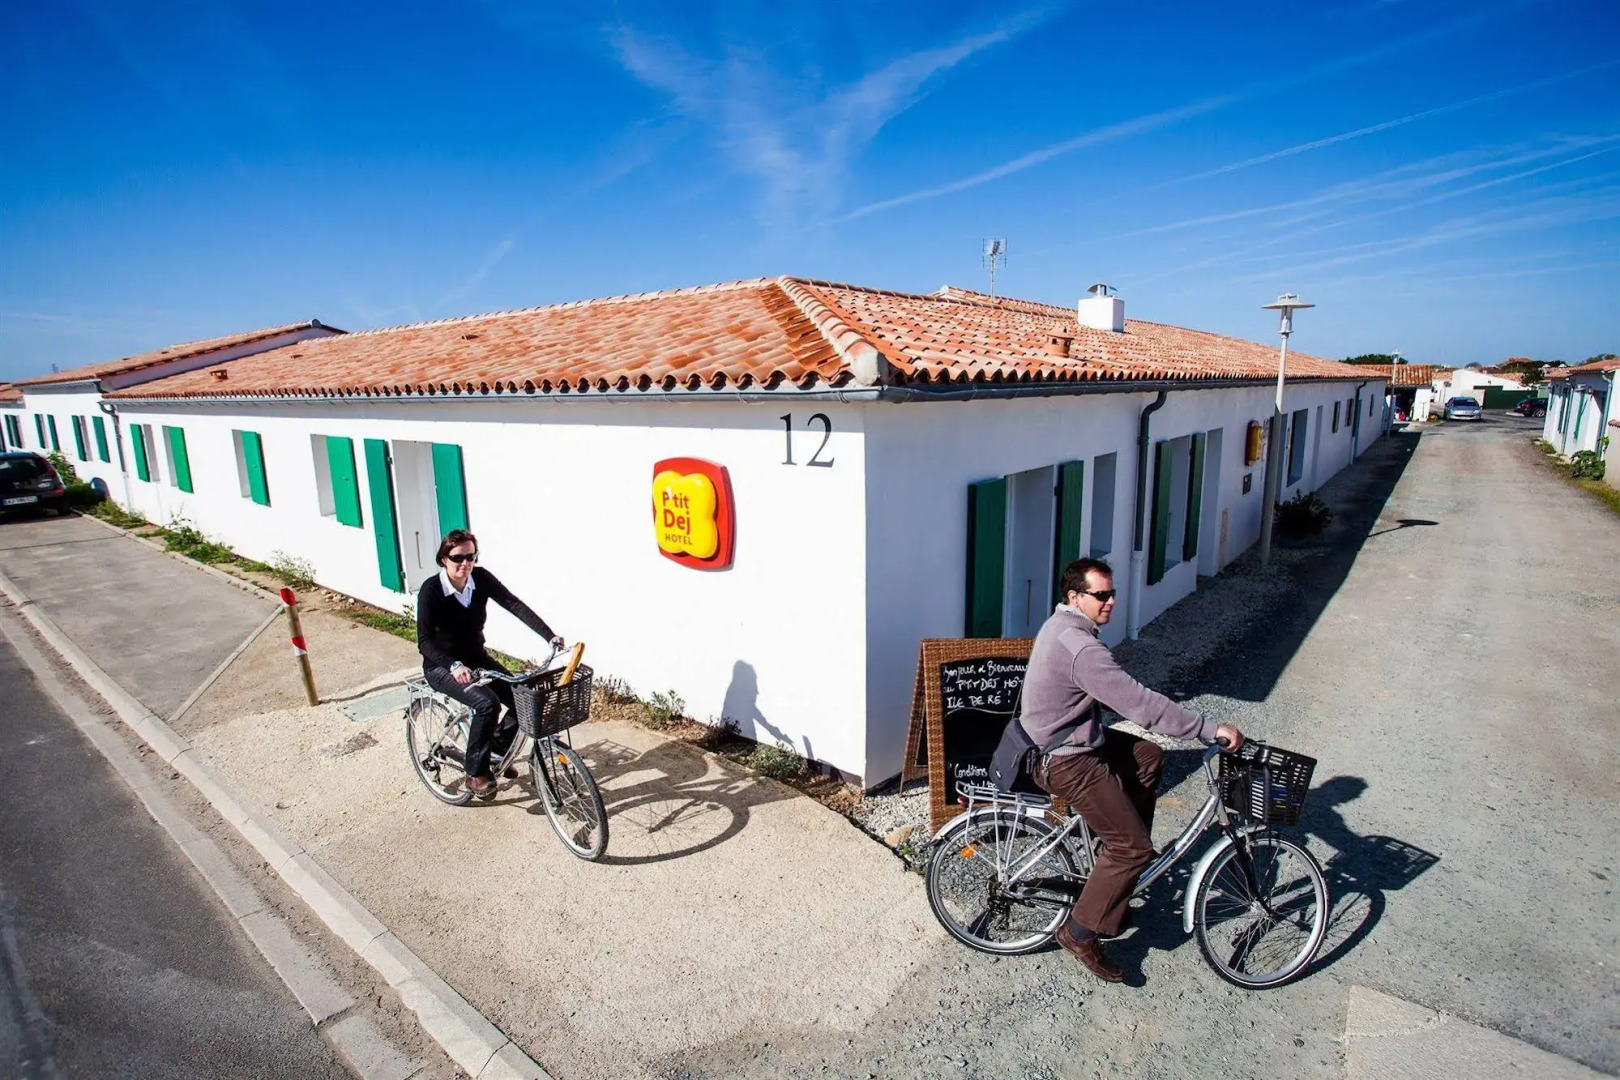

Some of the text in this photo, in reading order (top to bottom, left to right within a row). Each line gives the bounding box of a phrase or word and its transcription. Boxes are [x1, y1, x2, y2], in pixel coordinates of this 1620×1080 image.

[779, 412, 835, 468] 12
[663, 508, 691, 536] Dej
[665, 533, 693, 546] HOTEL
[947, 697, 965, 708] ILE
[968, 696, 985, 706] DE
[988, 691, 1001, 705] RÉ
